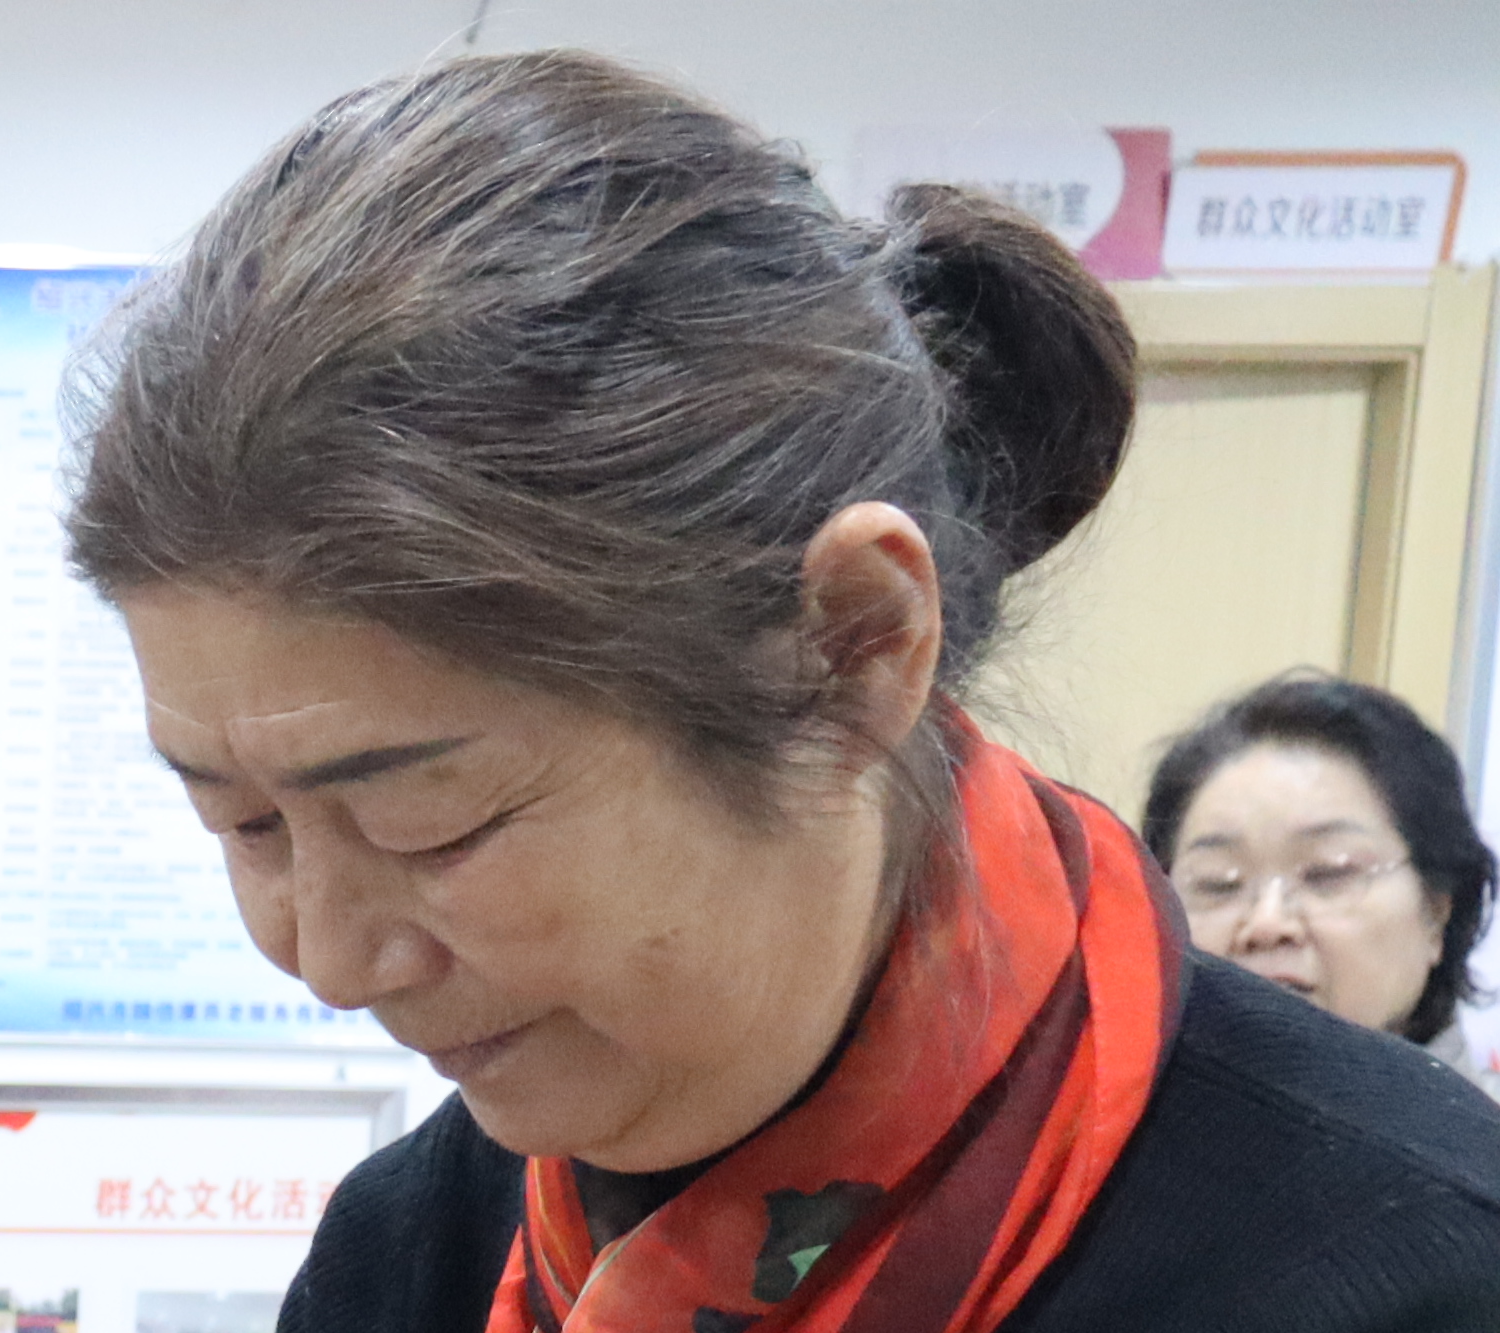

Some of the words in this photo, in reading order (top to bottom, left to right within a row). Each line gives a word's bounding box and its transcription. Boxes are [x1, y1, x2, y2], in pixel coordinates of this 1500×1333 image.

[1198, 195, 1428, 243] 群众文化活动室
